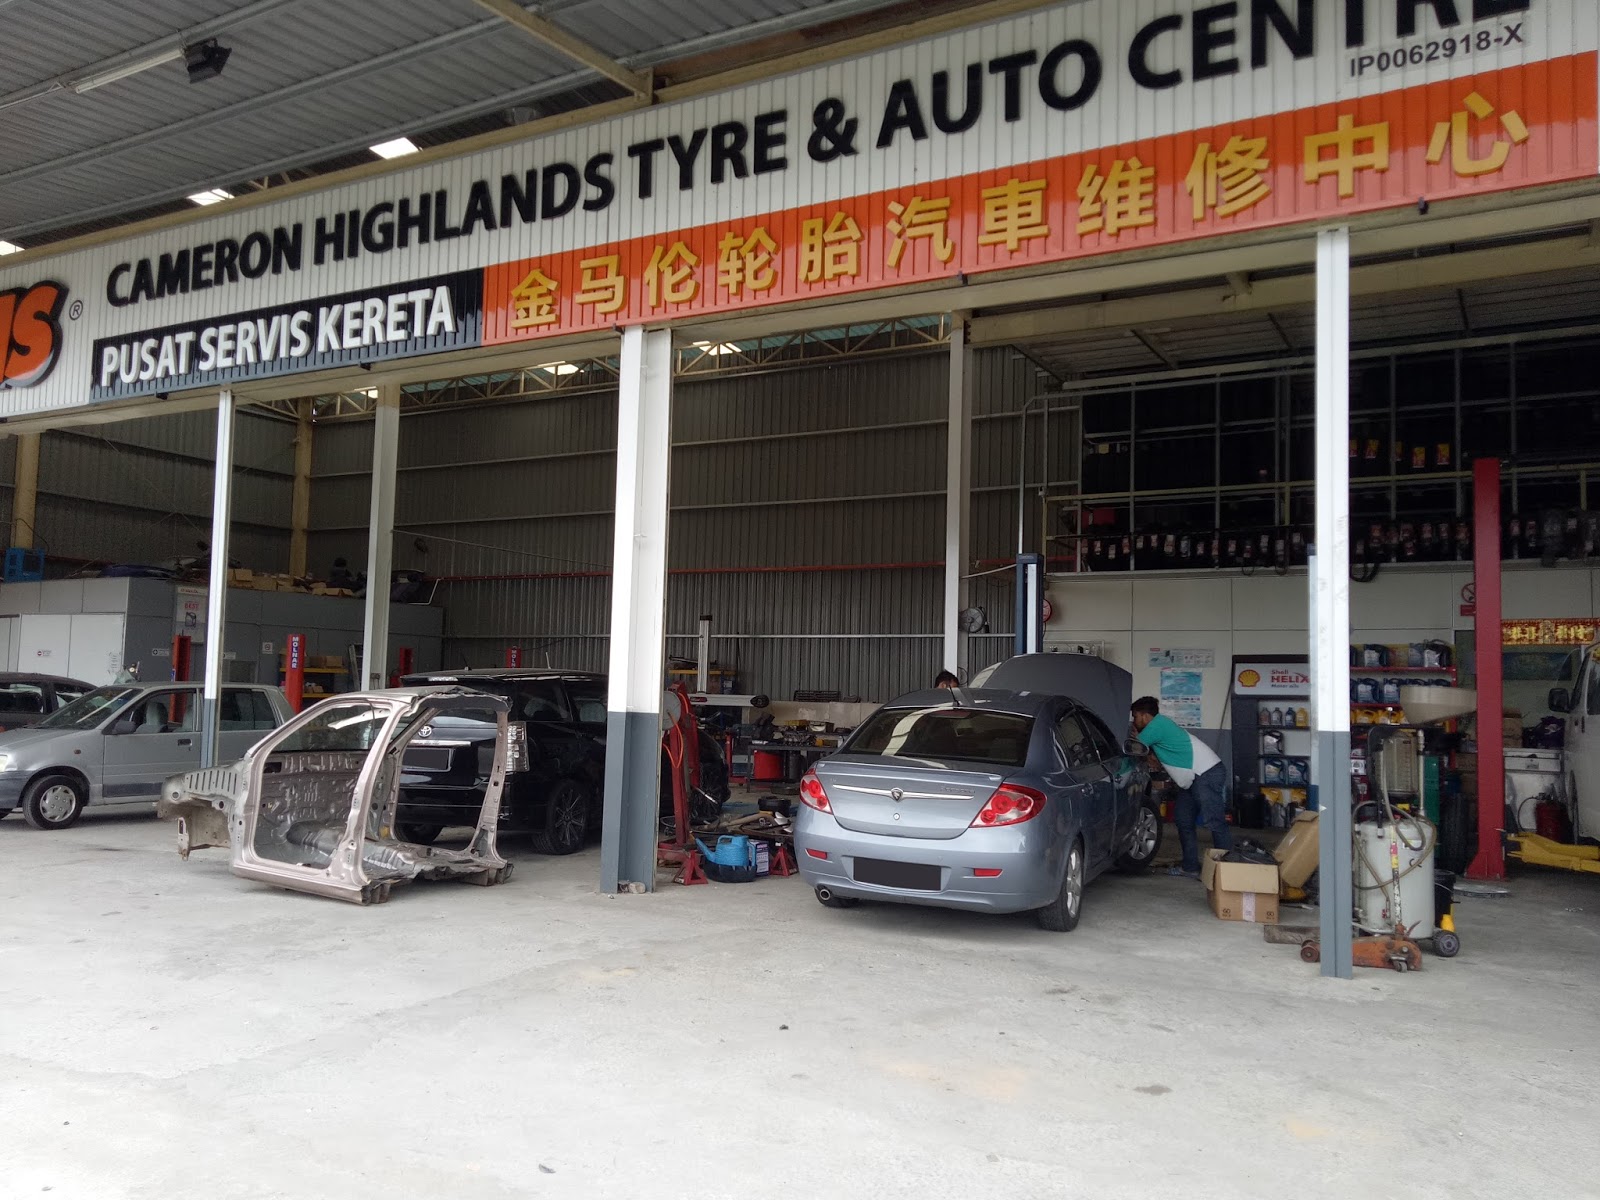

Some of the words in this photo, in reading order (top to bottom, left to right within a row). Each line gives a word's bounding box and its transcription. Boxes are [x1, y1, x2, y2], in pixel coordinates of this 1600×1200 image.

[1350, 23, 1524, 78] IP0062918-X
[107, 223, 301, 308] CAMERON
[313, 152, 616, 265] HIGHLANDS
[627, 109, 788, 200] TYRE
[807, 97, 859, 162] &
[876, 39, 1100, 148] AUTO
[510, 91, 1530, 329] 金马伦轮胎汽車维修中心
[101, 332, 195, 387] PUSAT
[199, 310, 311, 371] SERVIS
[317, 285, 456, 353] KERETA
[291, 636, 299, 669] MOLNAR
[1271, 672, 1310, 684] HELIX
